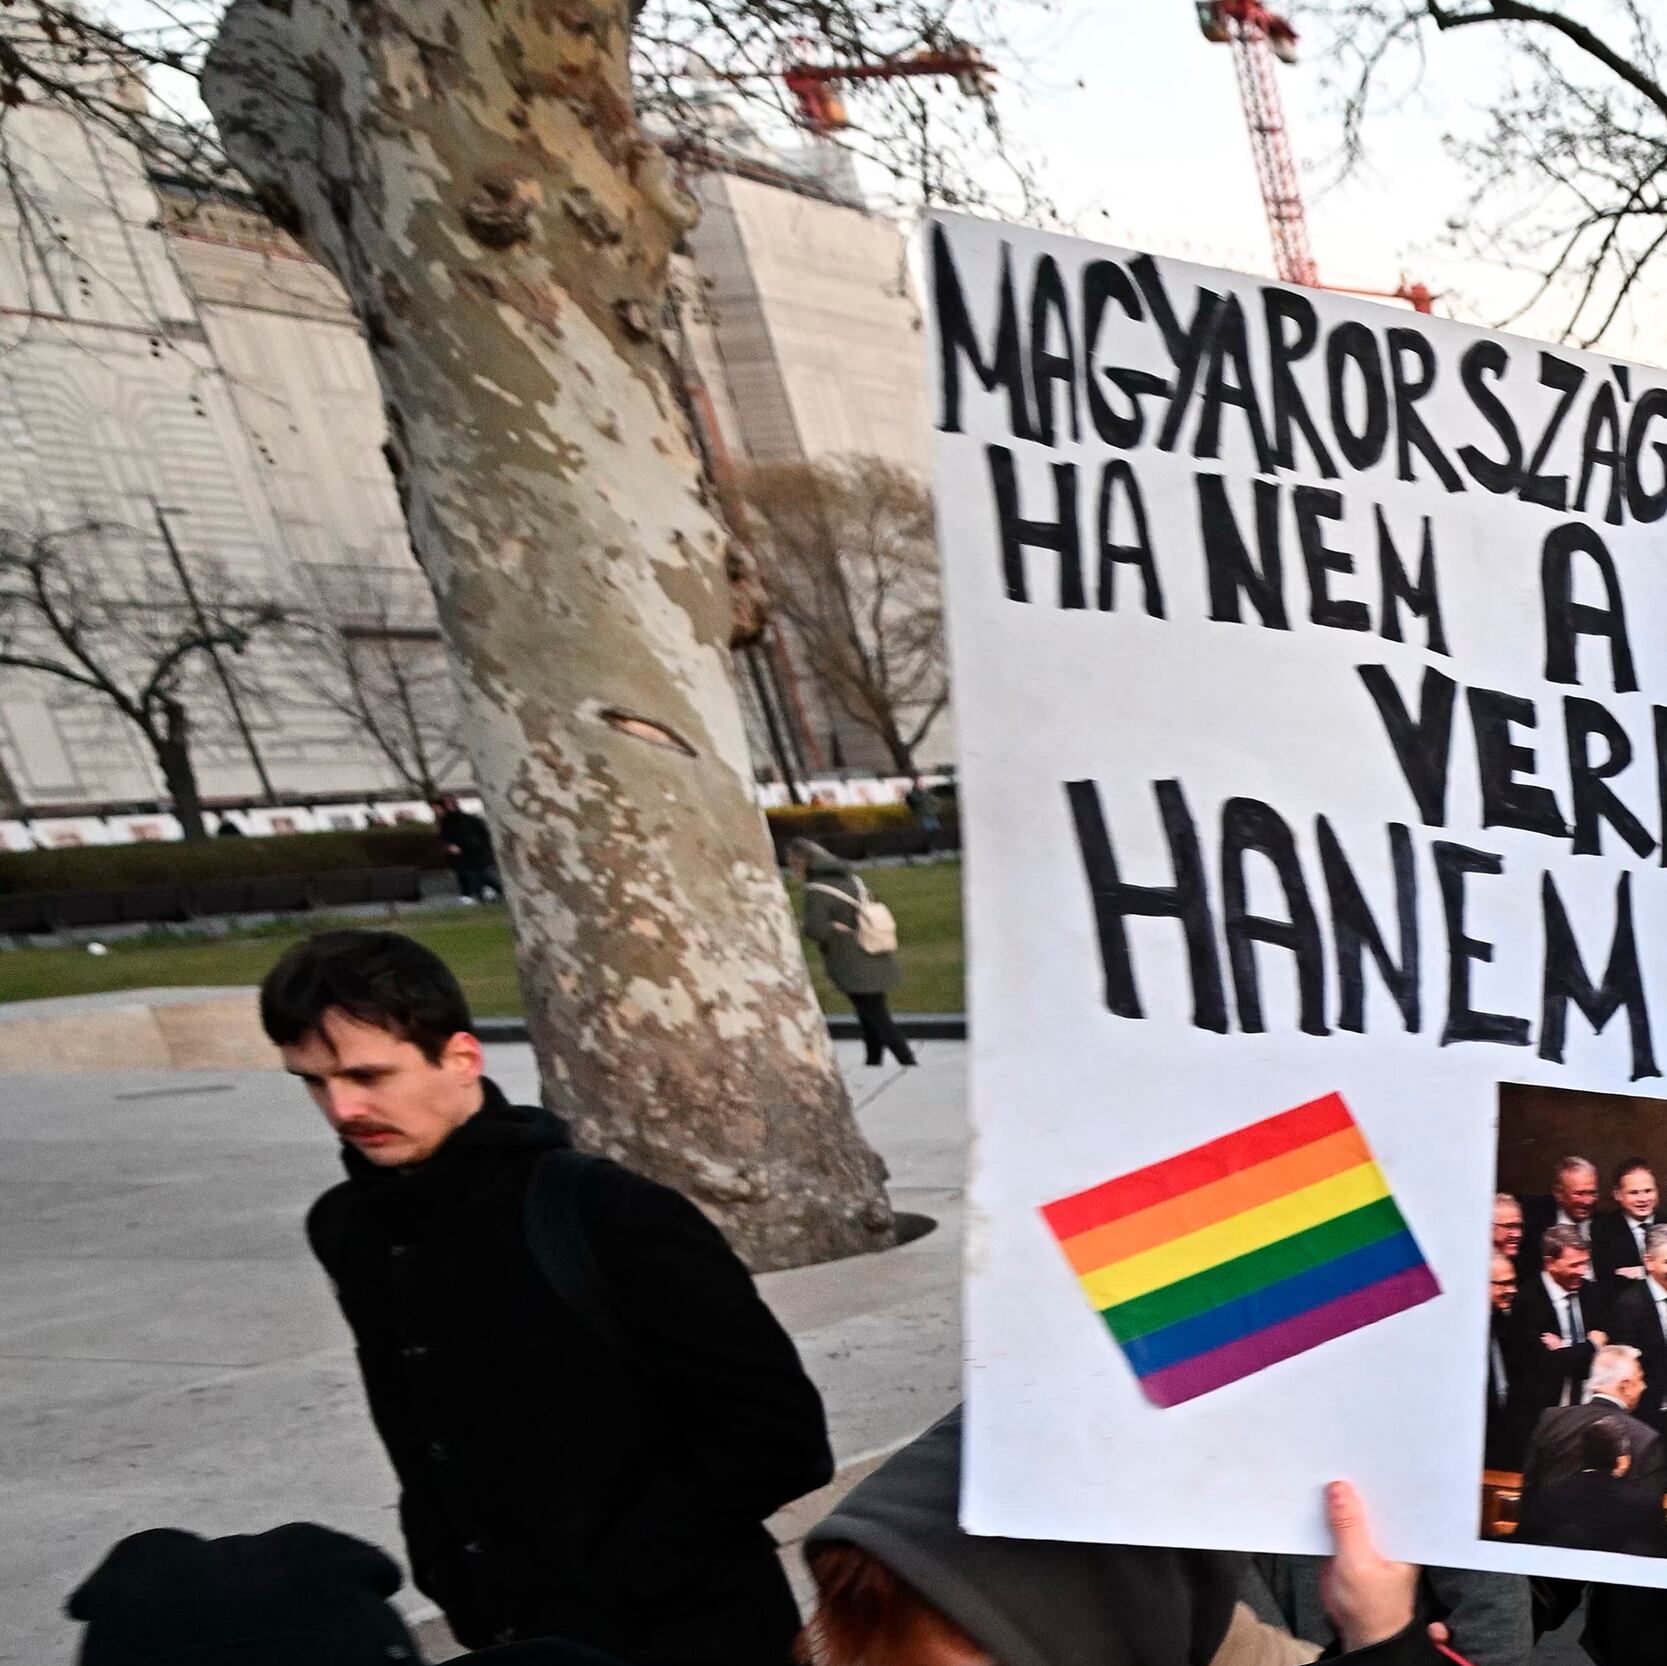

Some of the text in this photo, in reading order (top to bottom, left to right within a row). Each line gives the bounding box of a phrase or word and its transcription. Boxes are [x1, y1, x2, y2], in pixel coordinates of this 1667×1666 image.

[988, 444, 1166, 621] HA
[1193, 471, 1454, 658] NEM
[1541, 521, 1641, 694] A
[1060, 777, 1662, 1083] HANEM
